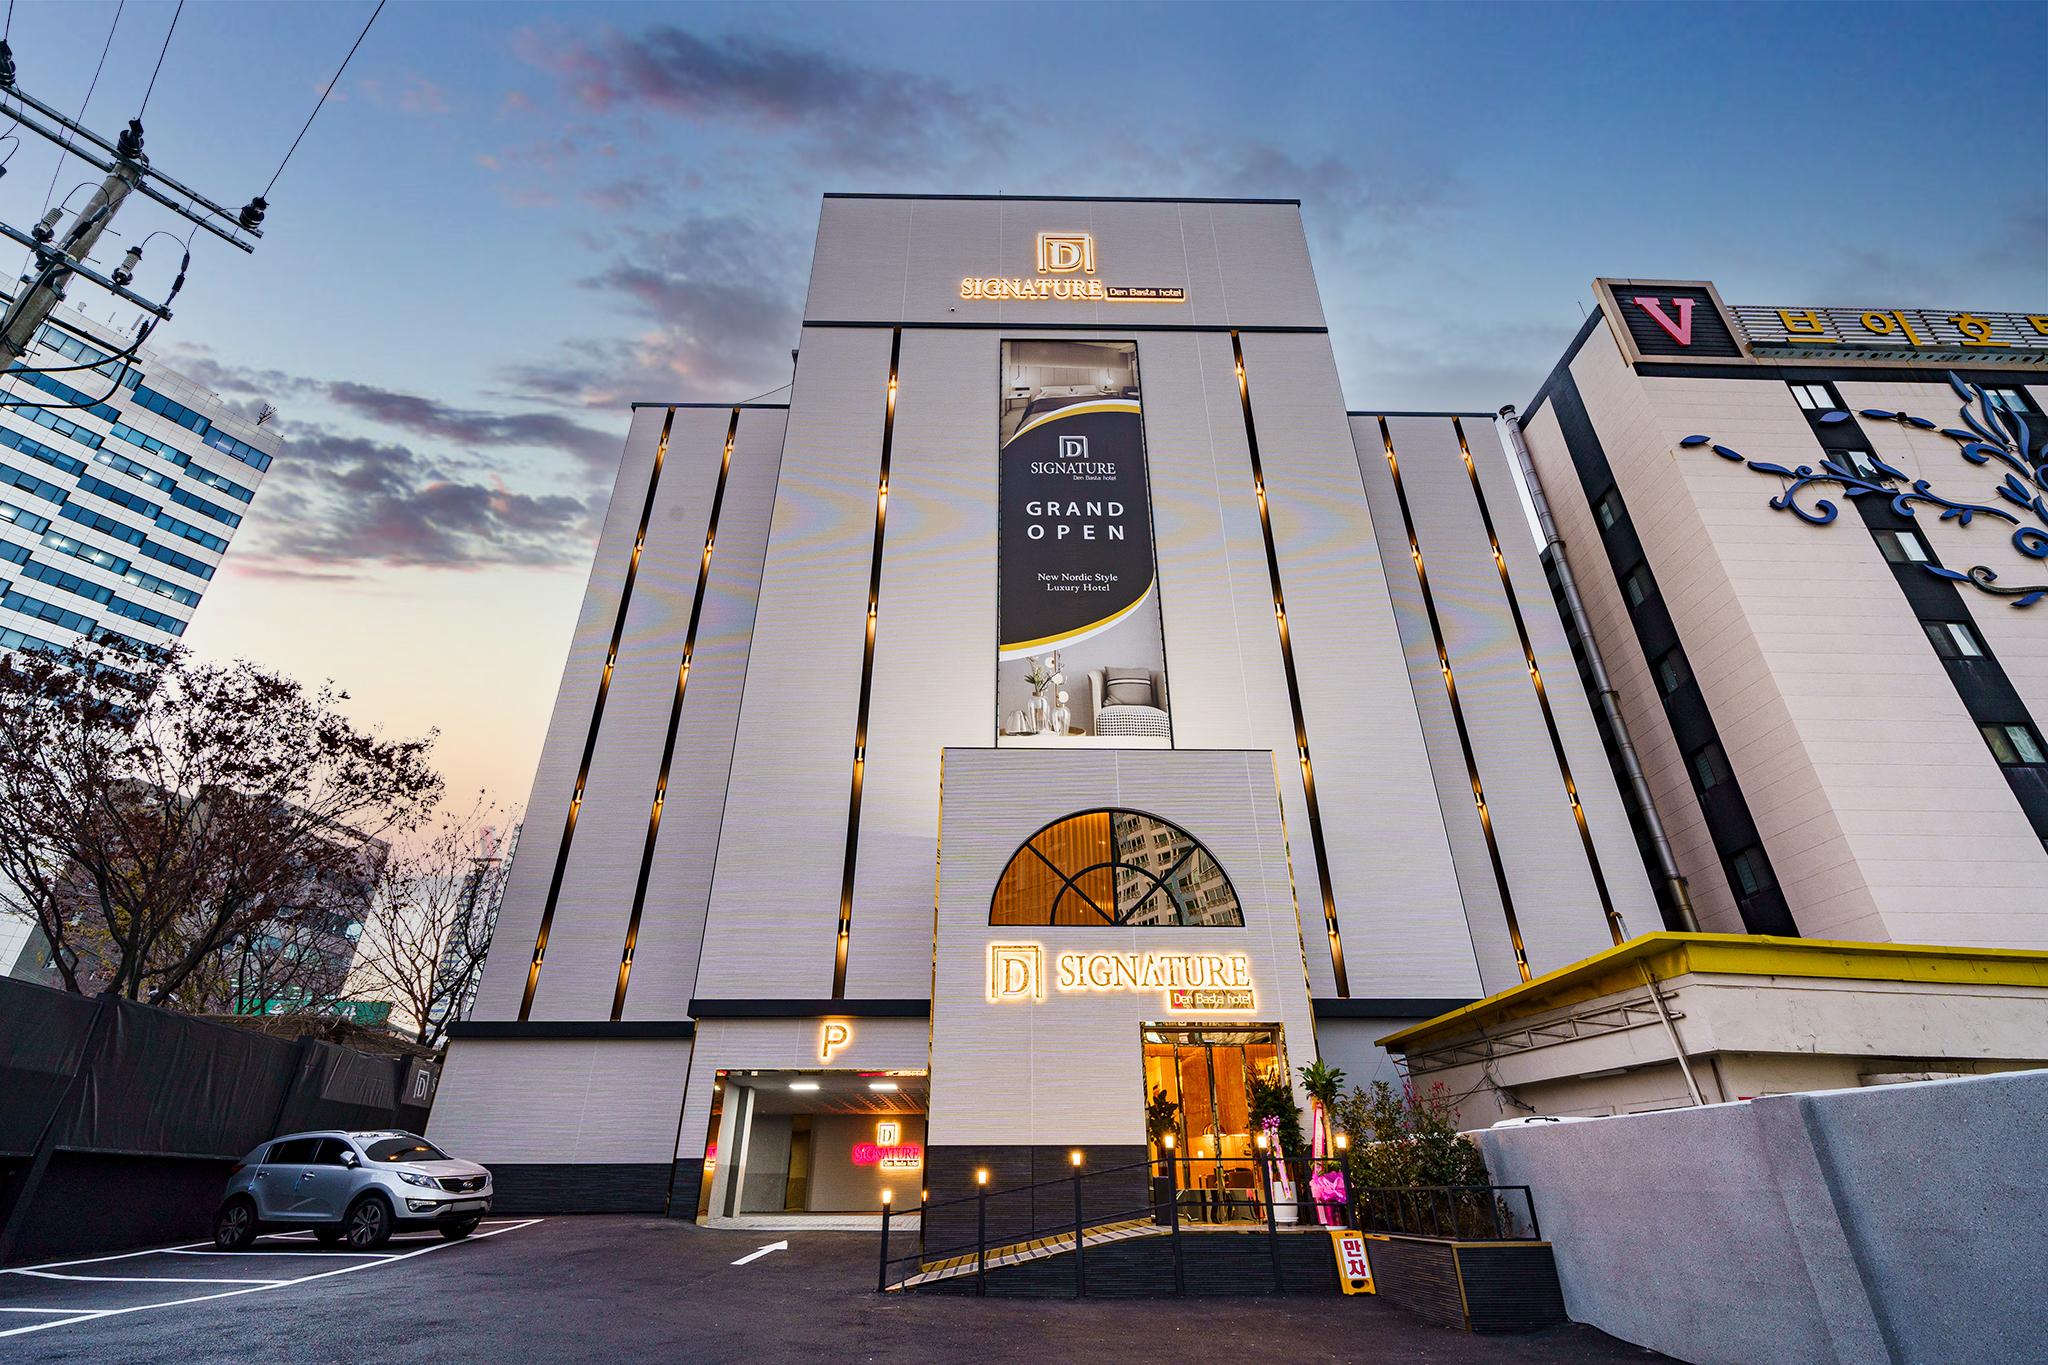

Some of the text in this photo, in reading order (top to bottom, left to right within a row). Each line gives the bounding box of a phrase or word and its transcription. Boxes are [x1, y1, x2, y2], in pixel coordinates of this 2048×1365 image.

[961, 278, 1103, 298] SIGNATURE
[1109, 288, 1182, 297] Den Basta hotel
[1633, 297, 1694, 345] V
[1030, 461, 1116, 475] SIGNATURE
[1026, 501, 1124, 517] GRAND
[1027, 524, 1124, 540] OPEN
[1038, 573, 1118, 583] New Nordic Style
[1047, 584, 1110, 593] Luxury Hotel
[1060, 955, 1251, 987] SIGNATURE
[1174, 993, 1252, 1004] Den Basta hotel
[823, 1024, 848, 1057] P
[855, 1146, 920, 1160] SIGNATURE
[1343, 1240, 1366, 1276] 만차
